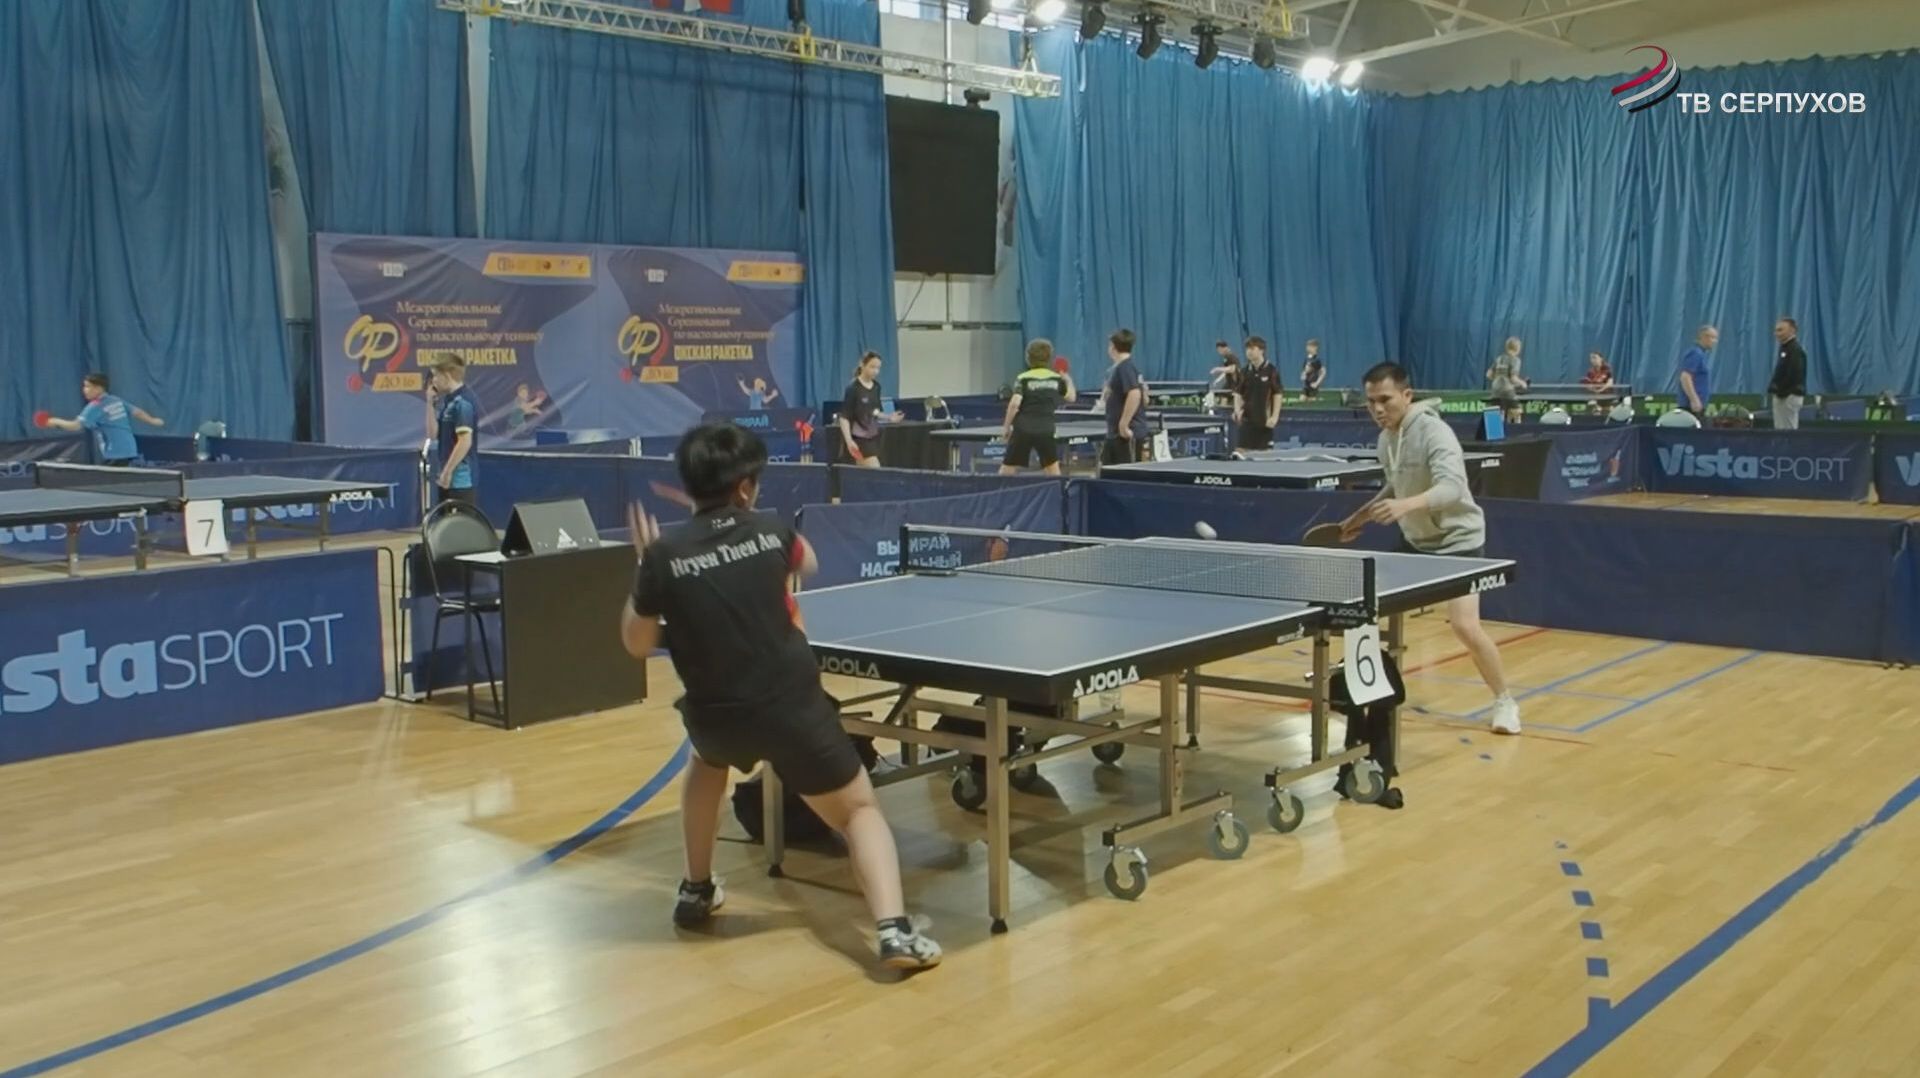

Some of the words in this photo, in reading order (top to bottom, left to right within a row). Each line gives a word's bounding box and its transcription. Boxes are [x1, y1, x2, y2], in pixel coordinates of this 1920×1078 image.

[467, 348, 518, 365] РАКЕТКА
[1657, 443, 1850, 481] VistaSPORT
[1202, 475, 1232, 485] JOOLA
[339, 491, 373, 501] JOOLA
[197, 518, 214, 548] 7
[877, 533, 951, 556] ВЫИРАЙ
[1477, 573, 1506, 592] JOOLA
[1335, 607, 1369, 618] JOOLA
[0, 612, 344, 714] staSPORT
[818, 655, 882, 680] JOOLA
[1355, 633, 1377, 688] 6
[1086, 664, 1140, 696] JOOLA
